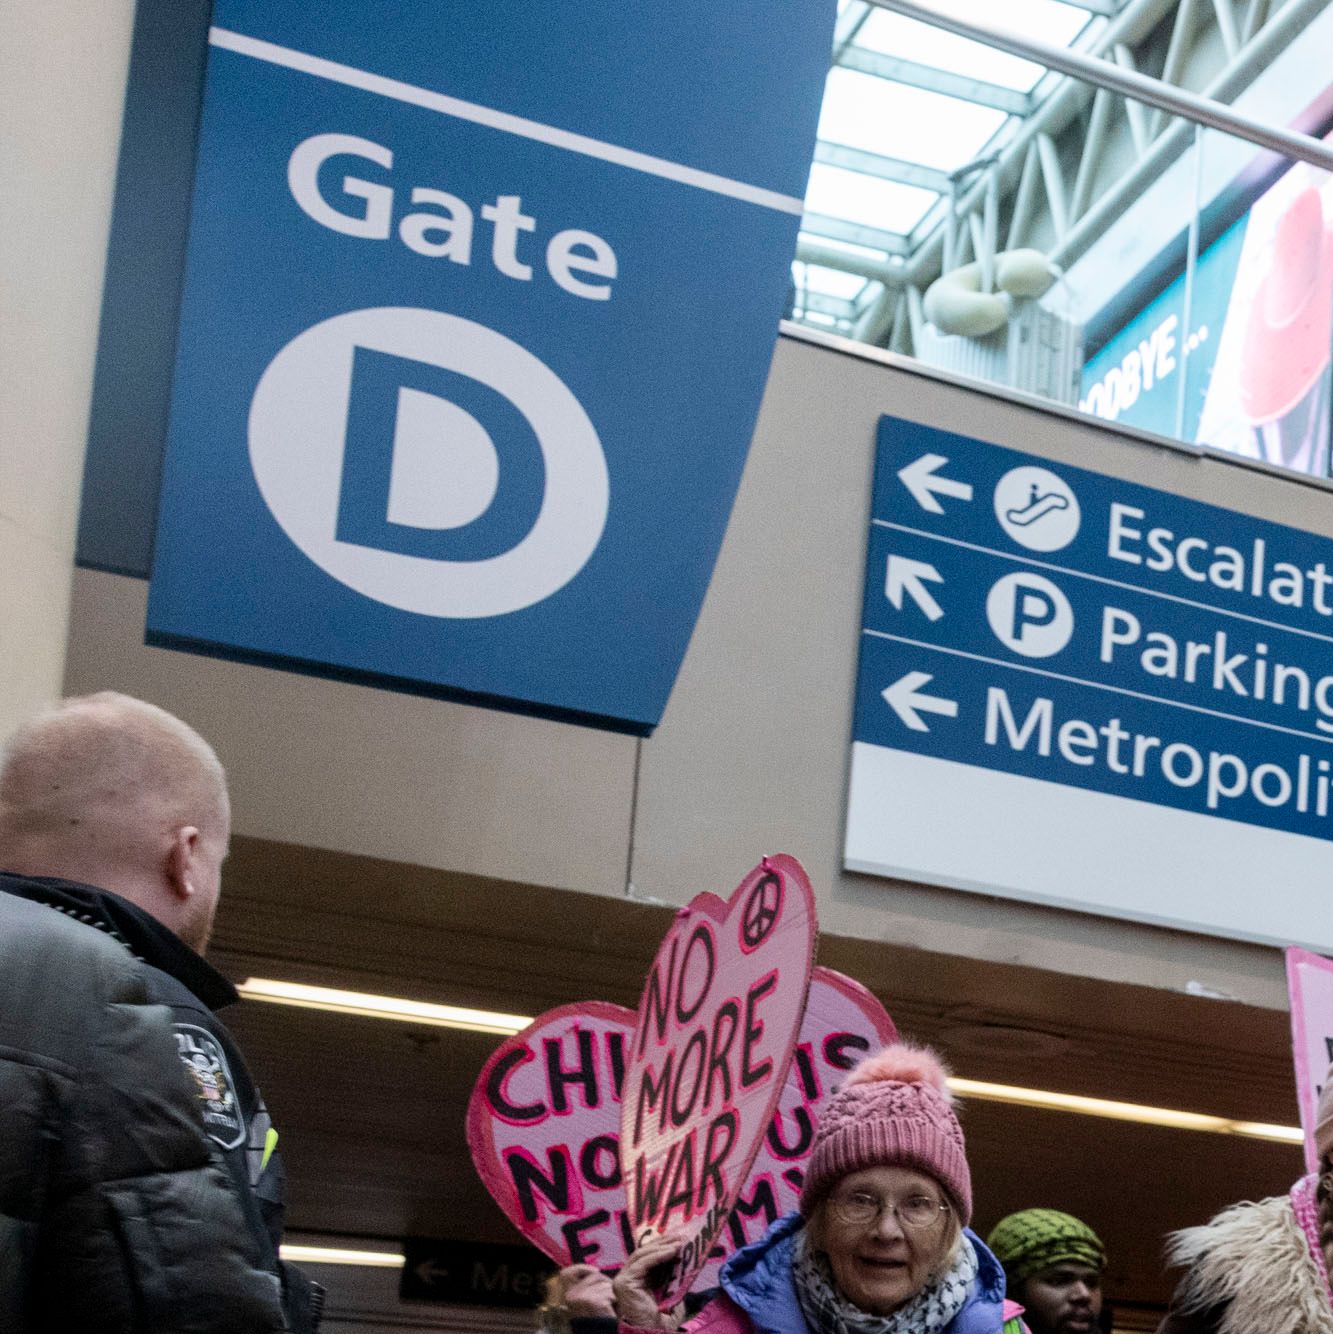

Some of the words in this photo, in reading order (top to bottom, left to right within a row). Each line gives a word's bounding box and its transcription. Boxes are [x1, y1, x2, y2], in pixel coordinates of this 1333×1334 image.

[288, 134, 618, 300] Gate
[334, 344, 547, 564] D
[633, 973, 777, 1147] MORE
[639, 924, 715, 1056] NO
[507, 1135, 623, 1223] NO
[634, 1111, 737, 1228] WAR
